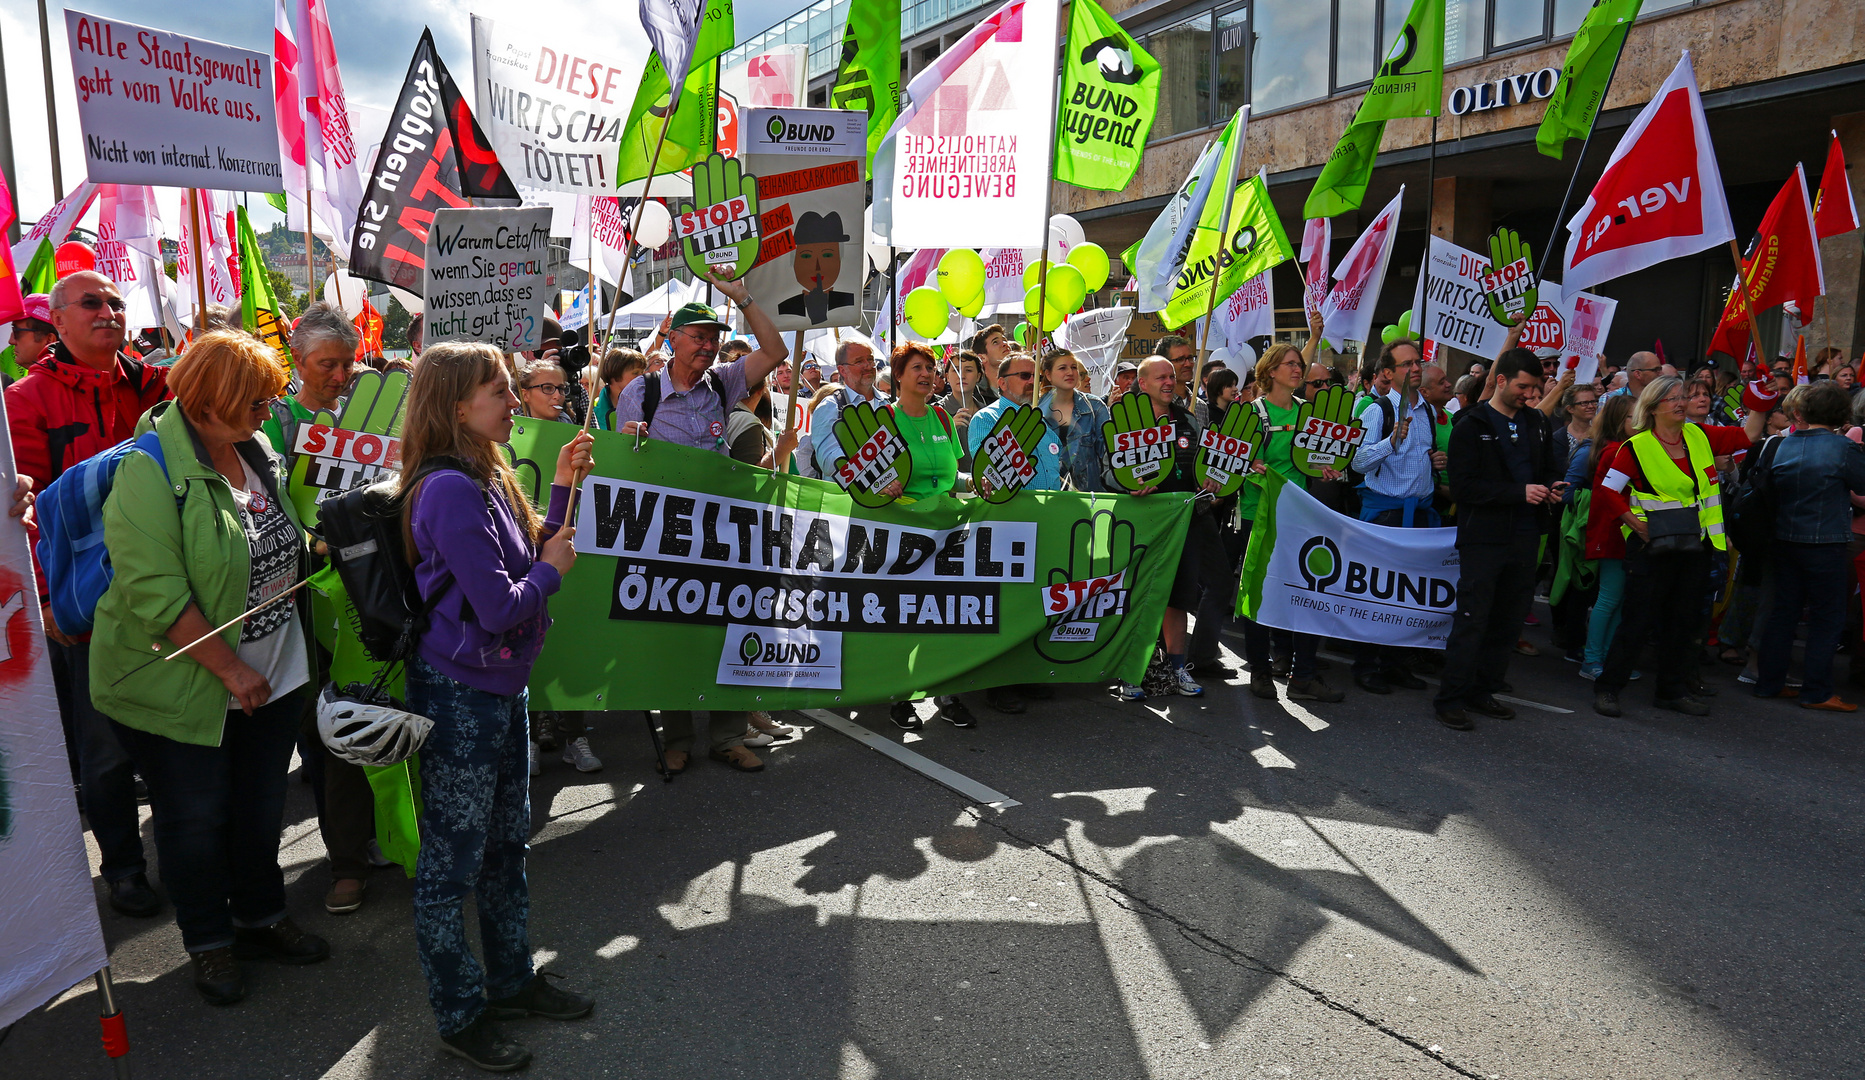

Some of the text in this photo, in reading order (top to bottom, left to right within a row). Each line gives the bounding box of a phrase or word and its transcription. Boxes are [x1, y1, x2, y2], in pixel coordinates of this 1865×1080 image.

[77, 17, 262, 89] Alle Staatsgewalt
[506, 43, 531, 59] Papst
[1221, 26, 1242, 52] OLIVO
[486, 49, 529, 71] Franziskus
[534, 46, 622, 105] DIESE
[78, 67, 261, 122] geht vom Volke aus.
[1071, 82, 1138, 118] BUND
[1448, 66, 1562, 116] OLIVO
[487, 77, 623, 143] WIRTSCHA
[1063, 98, 1142, 148] jugend
[786, 123, 835, 142] BUND
[87, 133, 283, 178] Nicht von internat. Konzernen.
[520, 139, 607, 188] TÖTET!
[758, 163, 858, 197] REIHANDELSABKOMMEN
[681, 199, 745, 234] STOP
[435, 224, 493, 257] Warum
[693, 215, 758, 252] TTIP!
[431, 265, 469, 280] wenn
[472, 256, 495, 279] Sie
[499, 259, 543, 286] genau
[716, 251, 733, 259] BUND
[1431, 255, 1457, 269] Franziskus
[1459, 253, 1490, 283] DIE
[1484, 260, 1526, 291] STOP
[1494, 271, 1537, 304] TTIP!
[517, 286, 532, 300] es
[431, 310, 467, 338] nicht
[471, 305, 500, 337] gut
[504, 303, 528, 332] für
[1434, 309, 1485, 349] TÖTET!
[1520, 321, 1561, 343] STOP
[1118, 424, 1172, 452] STOP
[1203, 430, 1249, 458] STOP
[1294, 432, 1350, 457] CETA!
[1306, 418, 1361, 442] STOP
[840, 430, 887, 483] STOP
[855, 436, 906, 489] TTIP!
[983, 436, 1020, 490] CETA!
[998, 430, 1033, 477] STOP
[1111, 442, 1169, 469] CETA!
[1141, 463, 1156, 472] BUND
[1206, 449, 1250, 478] TTIP!
[250, 523, 297, 559] OBODY SAID
[593, 483, 1025, 577] WELTHANDEL:
[261, 585, 269, 598] IT
[269, 577, 286, 594] WAS
[618, 564, 995, 625] ÖKOLOGISCH & FAIR!
[1344, 561, 1456, 609] BUND
[1290, 594, 1331, 613] FRIENDS
[1334, 603, 1346, 615] OF
[1350, 606, 1369, 620] THE
[1371, 611, 1404, 626] EARTH
[1066, 626, 1091, 635] BUND
[762, 642, 821, 664] BUND
[732, 669, 756, 678] FRIENDS
[766, 670, 775, 678] THE
[776, 670, 794, 678] EARTH
[794, 670, 821, 679] GERMANY
